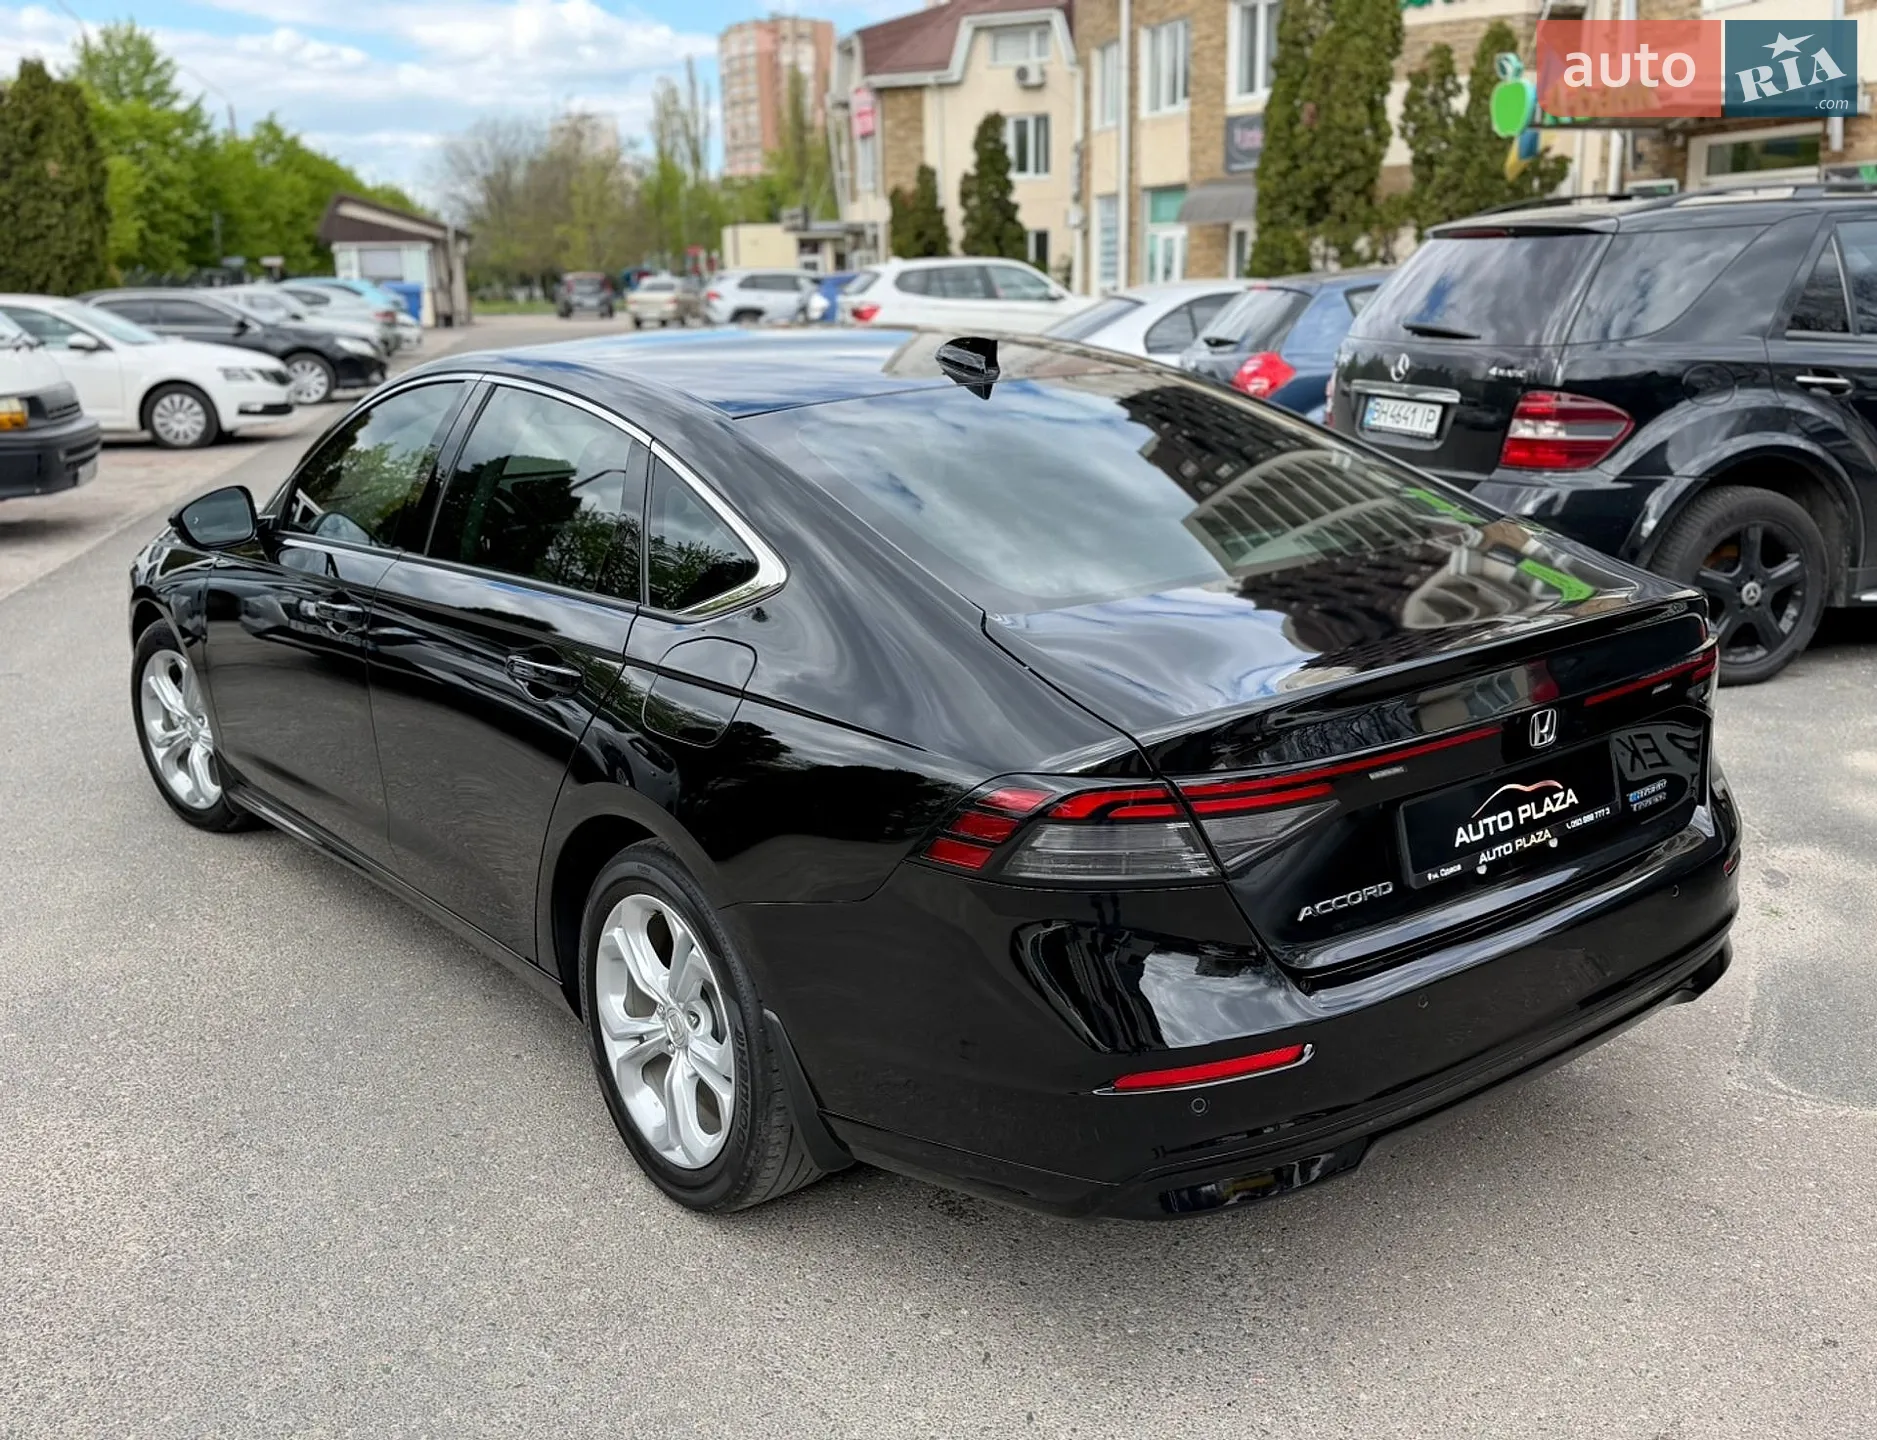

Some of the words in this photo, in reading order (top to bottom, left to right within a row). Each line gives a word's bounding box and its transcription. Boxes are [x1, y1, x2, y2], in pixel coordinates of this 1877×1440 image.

[1454, 811, 1514, 848] AUTO
[1518, 788, 1579, 825] PLAZA
[1478, 842, 1513, 865] AUTO
[1515, 829, 1552, 852] PLAZA
[1297, 881, 1394, 922] ACCORD
